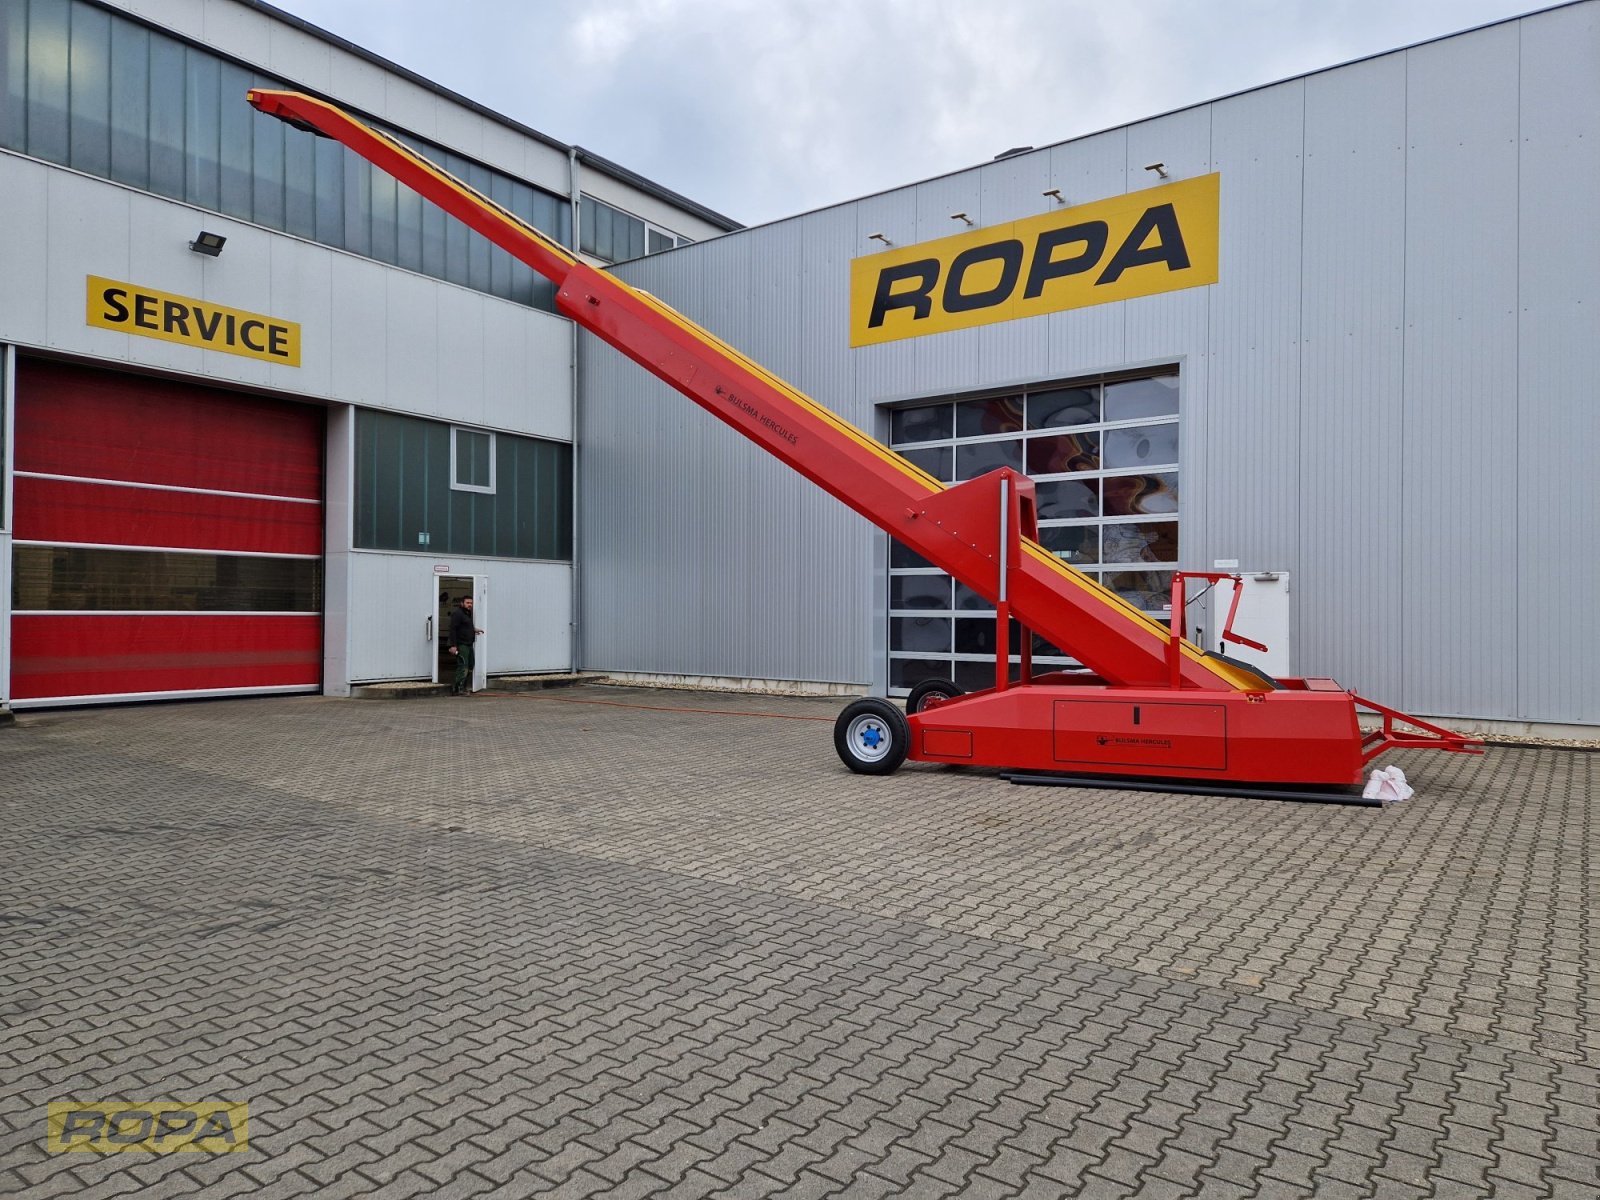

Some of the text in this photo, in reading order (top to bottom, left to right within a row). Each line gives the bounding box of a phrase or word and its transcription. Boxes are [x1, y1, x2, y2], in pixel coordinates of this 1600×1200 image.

[867, 202, 1191, 329] ROPA
[103, 287, 289, 357] SERVICE
[760, 414, 798, 446] HERCULES
